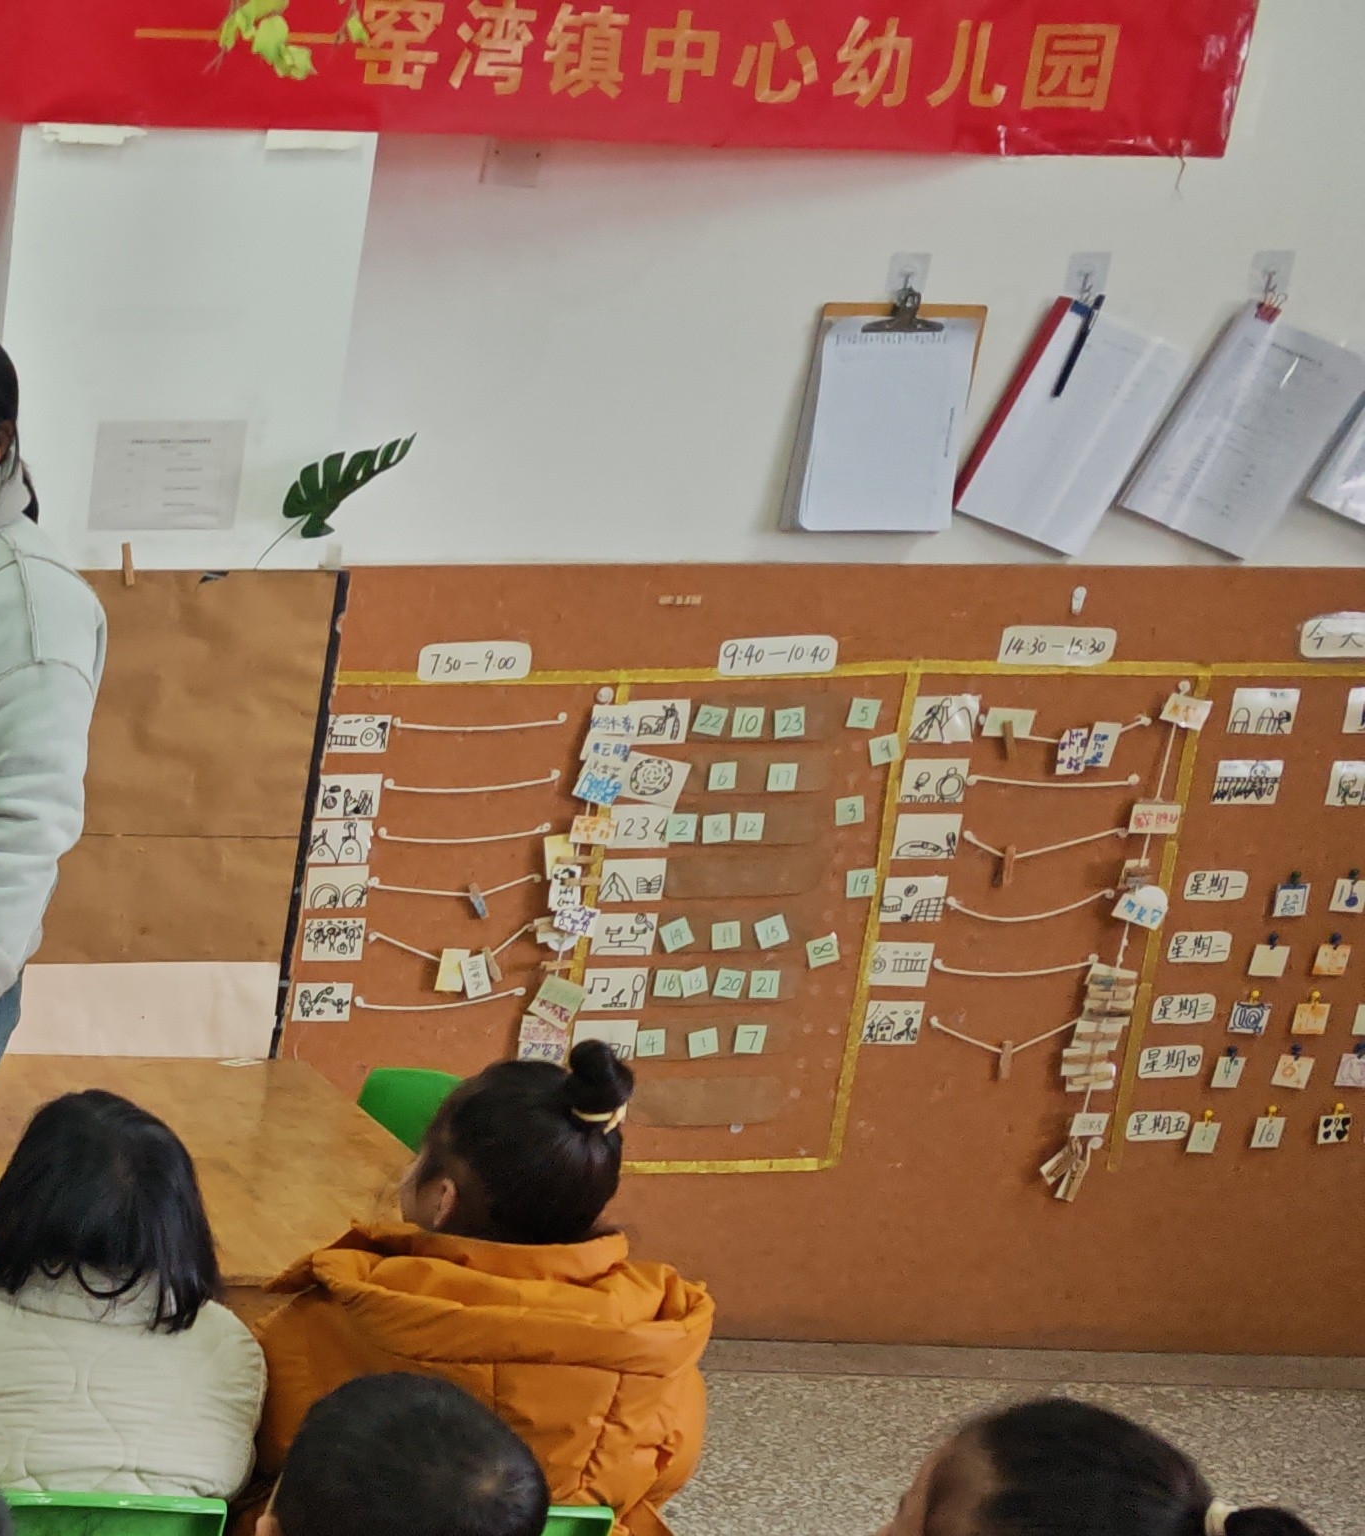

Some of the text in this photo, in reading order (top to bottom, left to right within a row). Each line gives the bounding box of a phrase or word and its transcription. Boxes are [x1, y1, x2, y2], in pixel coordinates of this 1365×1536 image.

[355, 0, 1121, 112] 窑湾镇中心幼儿园
[699, 711, 803, 733] 22 10 23
[857, 705, 869, 722] 5
[674, 820, 689, 837] 2
[1186, 873, 1244, 898] 星期一
[1170, 935, 1228, 960] 星期二
[720, 976, 743, 992] 20
[755, 976, 774, 993] 21
[1154, 996, 1213, 1021] 星期三
[645, 1034, 658, 1053] 4
[743, 1030, 759, 1050] 7
[1141, 1048, 1200, 1075] 星期四
[1129, 1113, 1187, 1137] 星期五
